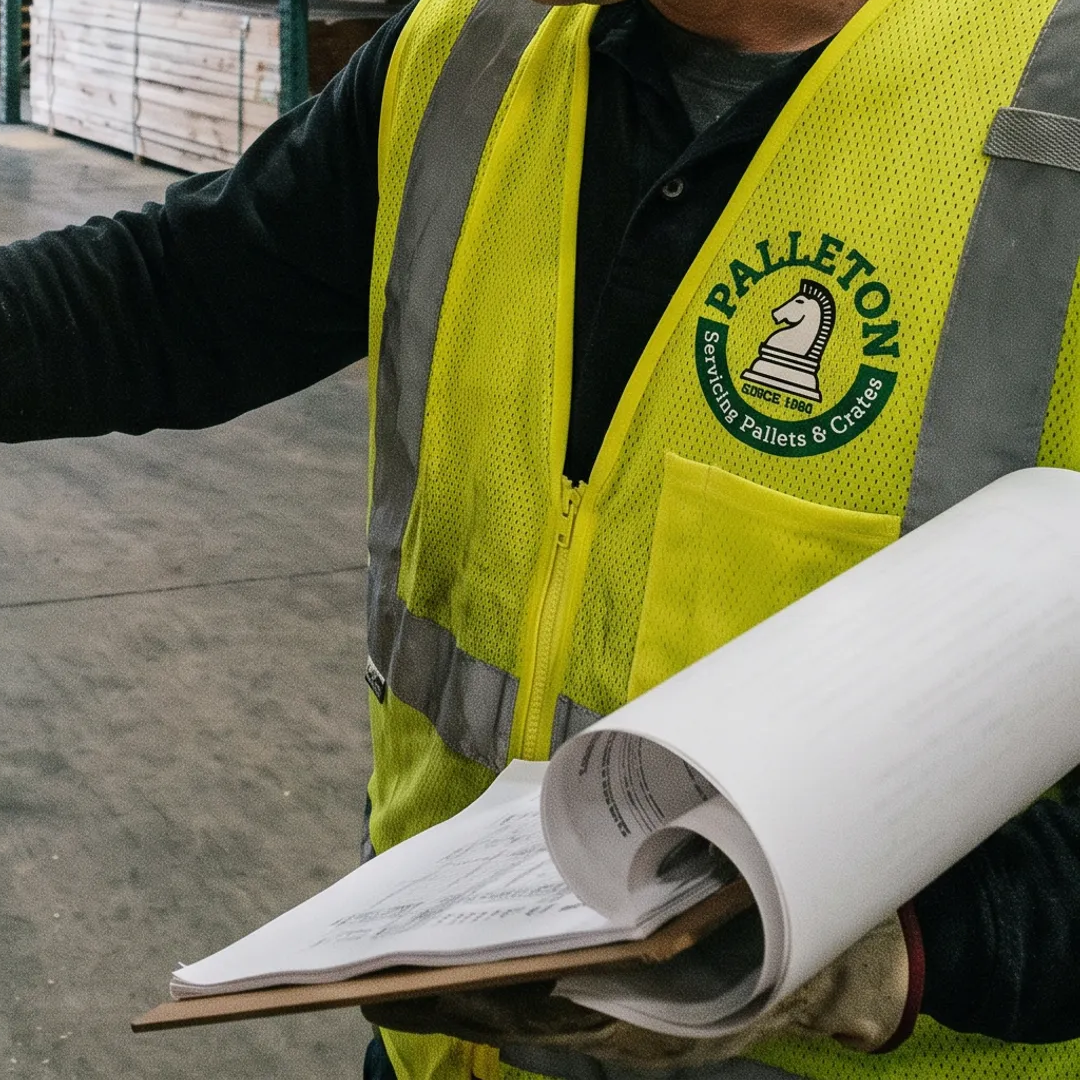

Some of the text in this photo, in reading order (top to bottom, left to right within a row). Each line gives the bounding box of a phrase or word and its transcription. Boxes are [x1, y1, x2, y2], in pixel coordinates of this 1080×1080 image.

[704, 231, 901, 358] PALLETON
[704, 330, 883, 447] Servicing Pallets & Crates
